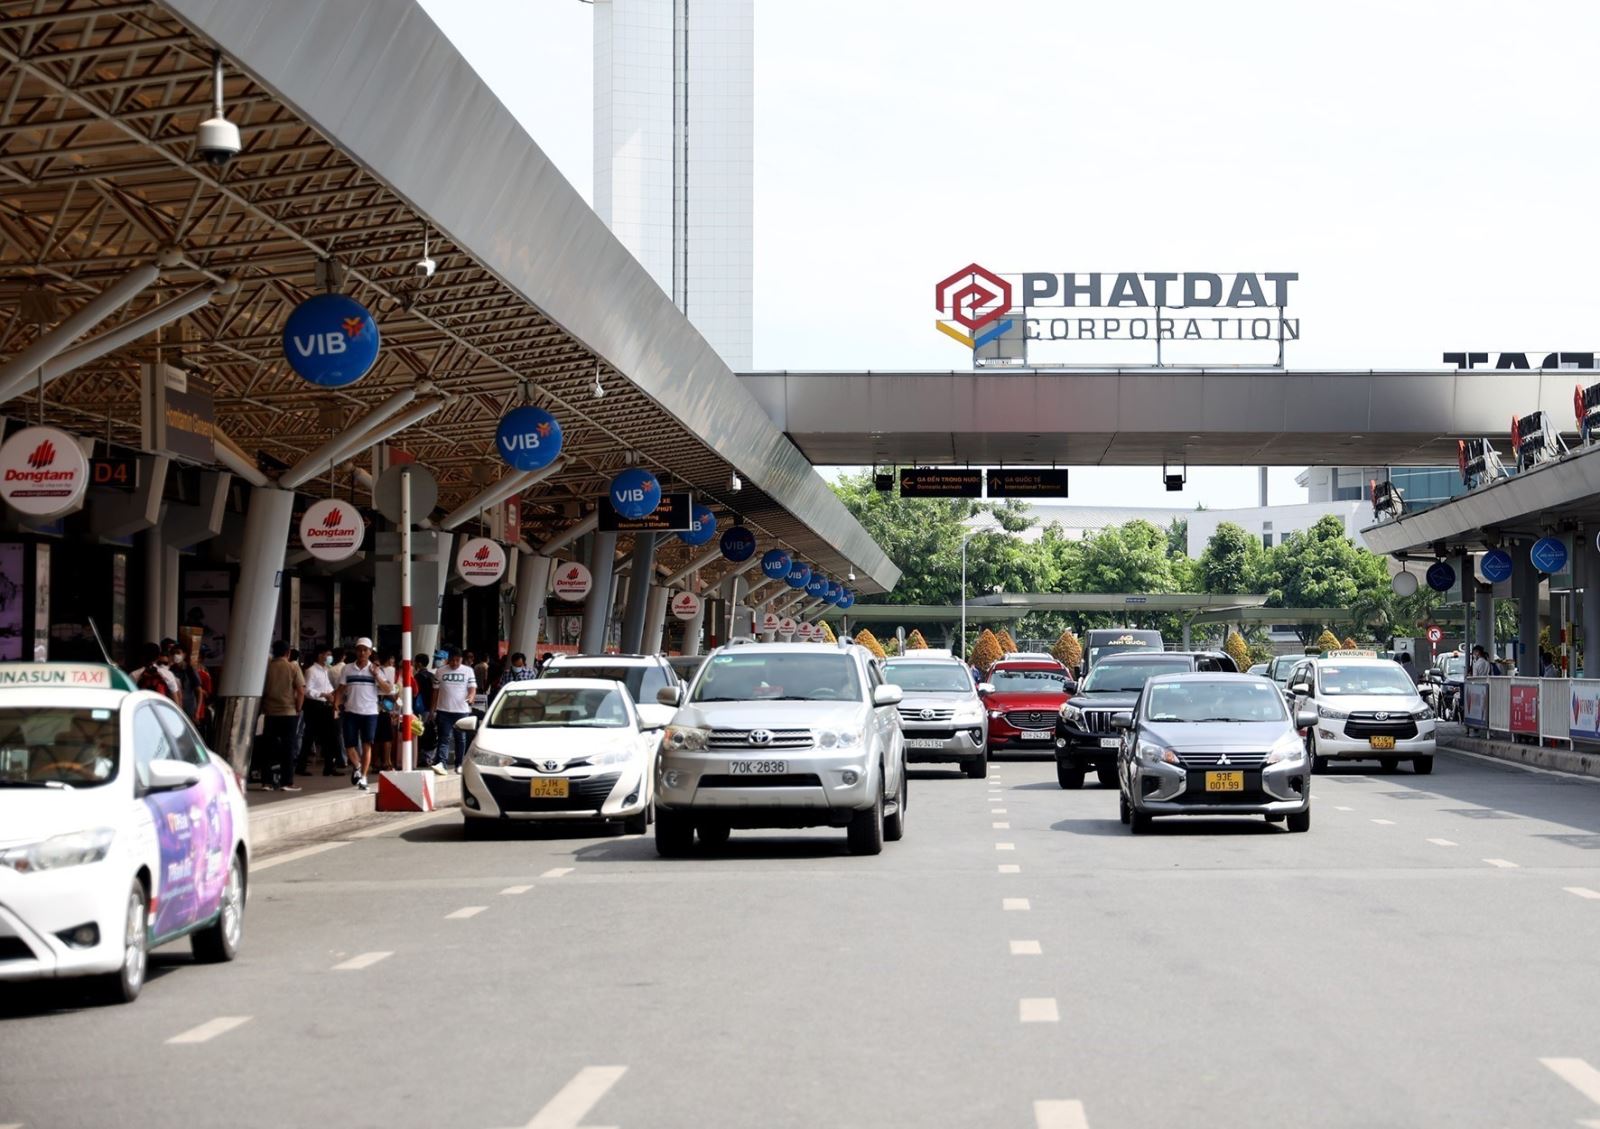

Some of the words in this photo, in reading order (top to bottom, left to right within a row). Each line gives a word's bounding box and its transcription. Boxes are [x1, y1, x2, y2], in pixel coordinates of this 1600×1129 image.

[1023, 272, 1299, 307] PHATDAT
[1024, 318, 1300, 341] CORPORATION
[293, 332, 347, 357] VIB
[502, 433, 541, 451] VIB
[5, 469, 75, 483] Dongtam
[94, 463, 128, 483] D4
[616, 489, 645, 503] VIB
[307, 528, 355, 538] Dongtam
[724, 541, 745, 551] VIB
[463, 560, 499, 569] Dongtam
[765, 561, 782, 570] VIB
[556, 579, 587, 588] Dongtam
[71, 670, 104, 683] TAXI
[1216, 773, 1233, 781] 93E
[541, 779, 559, 787] 51H
[1210, 782, 1239, 790] 001.99
